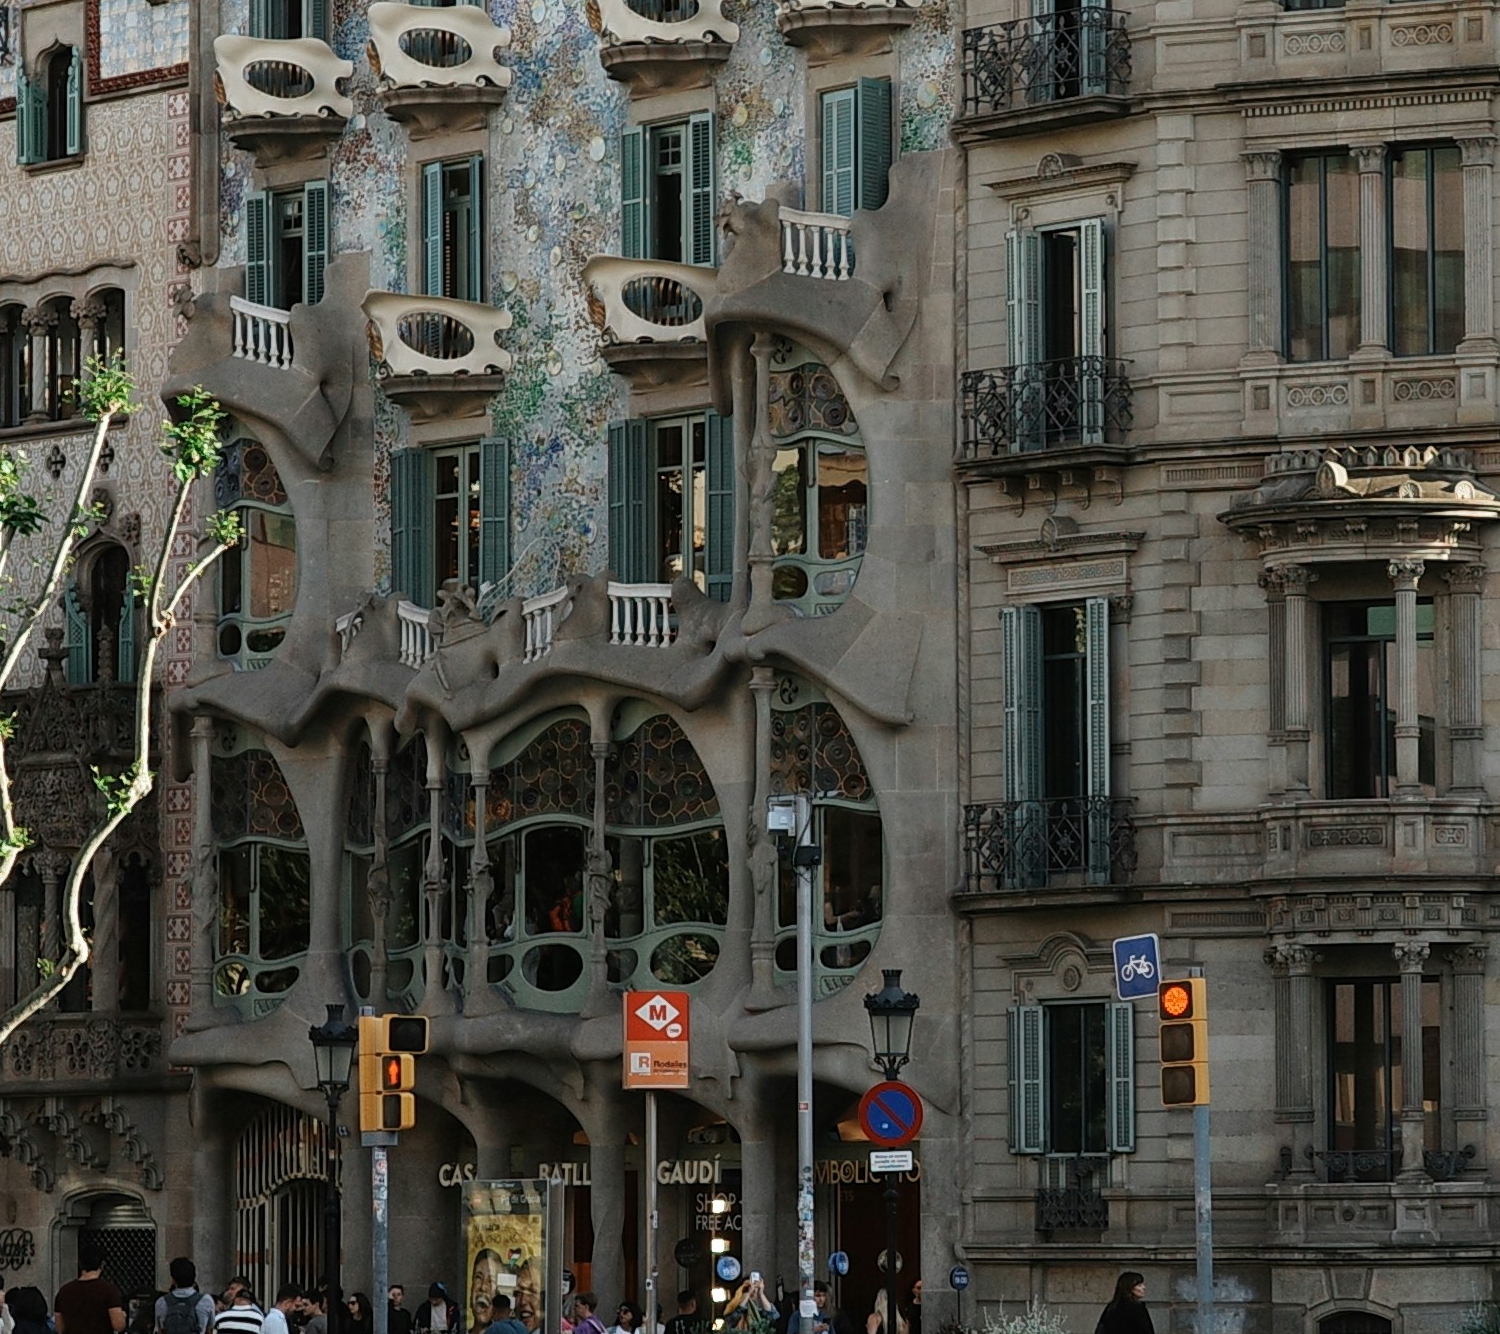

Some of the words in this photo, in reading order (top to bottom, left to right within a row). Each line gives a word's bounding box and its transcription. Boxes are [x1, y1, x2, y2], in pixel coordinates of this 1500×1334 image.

[649, 1005, 667, 1021] M
[439, 1163, 477, 1187] CAS
[657, 1153, 722, 1185] GAUDÍ
[695, 1214, 722, 1231] FREE
